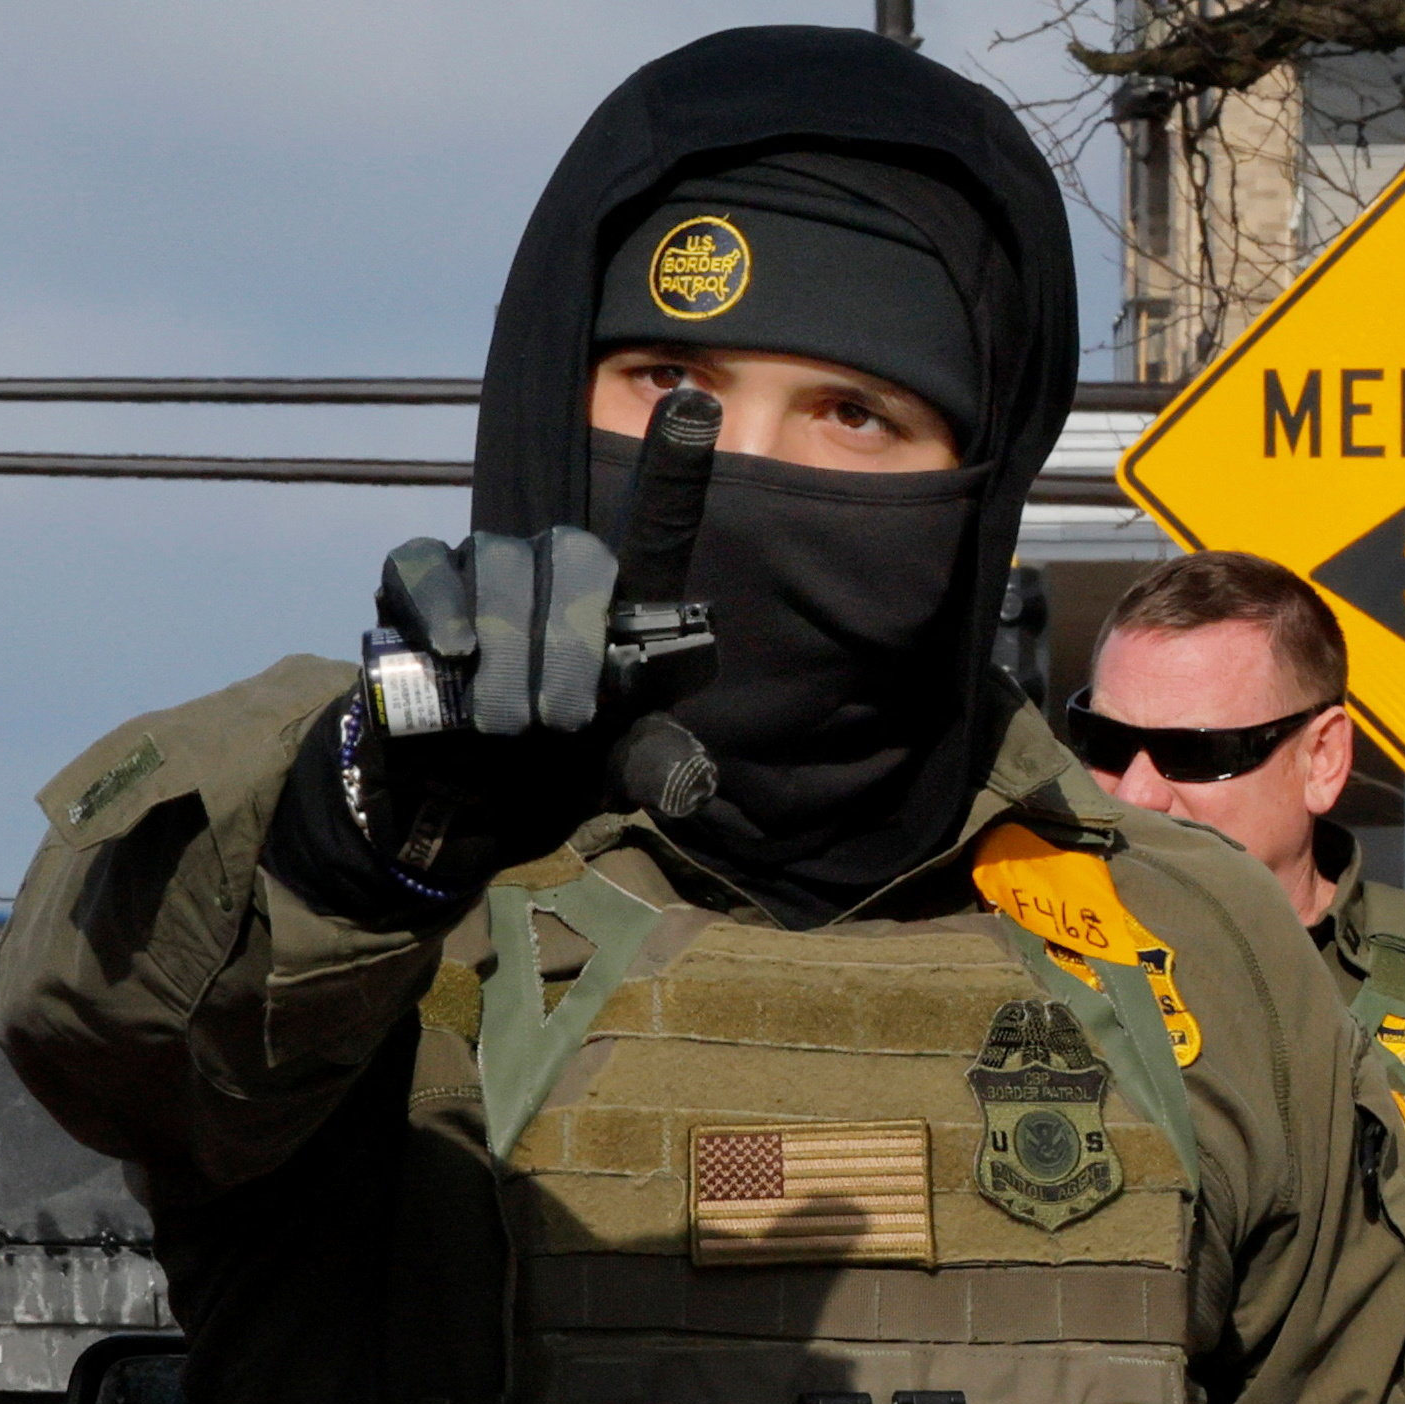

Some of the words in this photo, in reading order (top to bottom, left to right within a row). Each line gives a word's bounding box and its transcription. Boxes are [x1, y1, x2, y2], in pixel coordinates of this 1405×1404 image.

[687, 235, 716, 251] U.S.
[664, 256, 733, 273] BORDER
[661, 276, 730, 292] PATROL
[1025, 1072, 1050, 1085] CBP
[987, 1086, 1039, 1100] BORDER
[1042, 1086, 1092, 1100] PATROL
[991, 1130, 1008, 1152] U
[1086, 1131, 1103, 1152] S
[993, 1162, 1044, 1198] PATROL
[1058, 1163, 1105, 1199] AGENT
